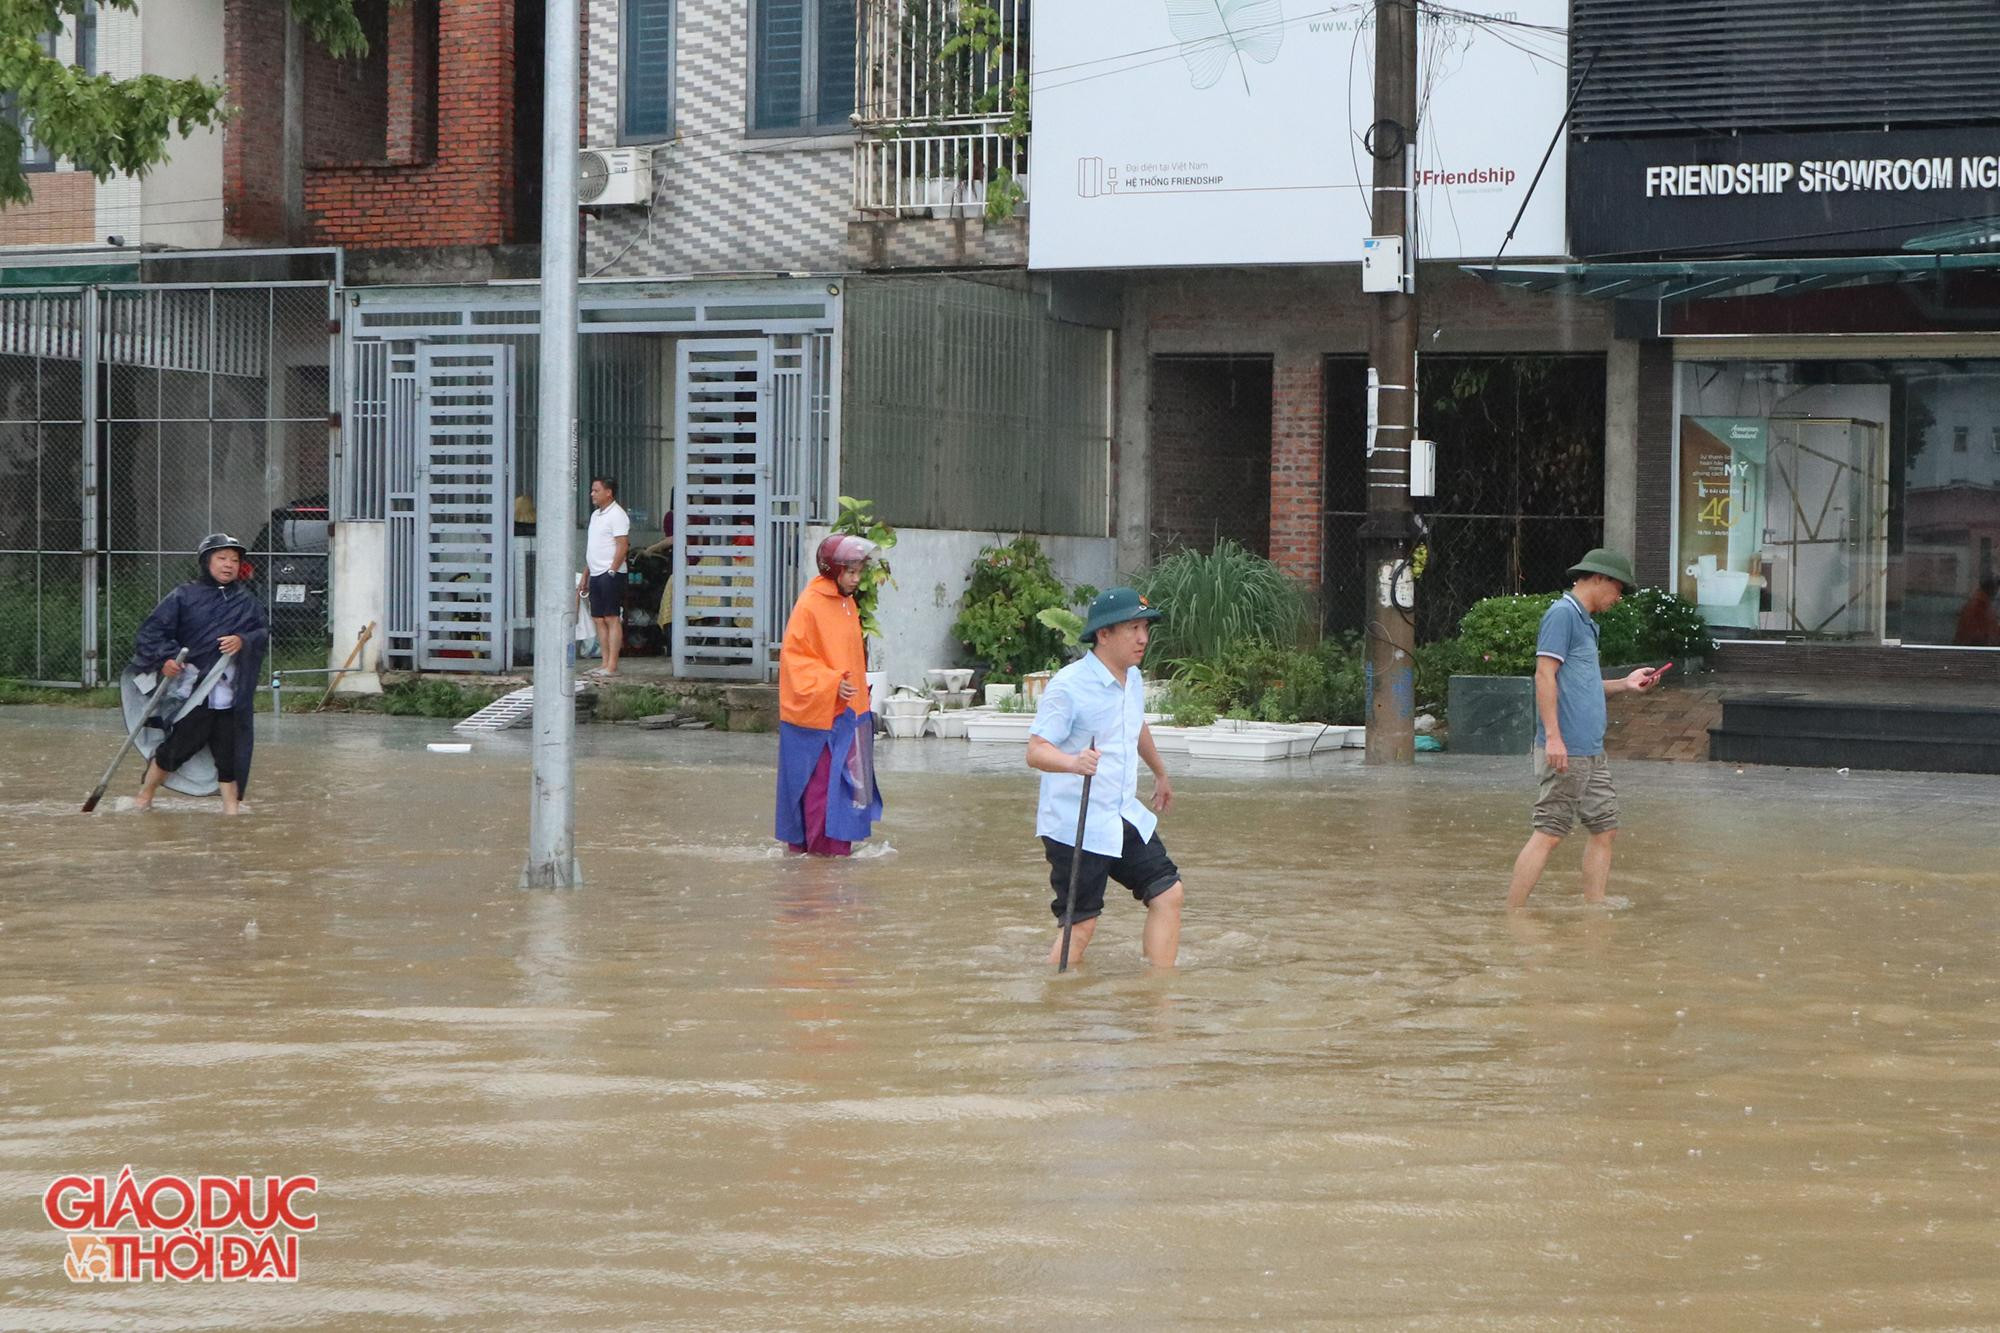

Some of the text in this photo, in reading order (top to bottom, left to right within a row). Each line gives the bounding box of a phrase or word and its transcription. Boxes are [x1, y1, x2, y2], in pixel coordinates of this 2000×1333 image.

[1188, 161, 1208, 170] Nam
[1171, 175, 1224, 186] FRIENDSHIP
[1423, 167, 1515, 185] Friendship
[1646, 155, 2000, 198] FRIENDSHIP SHOWROOM NG
[1724, 461, 1749, 477] MỸ
